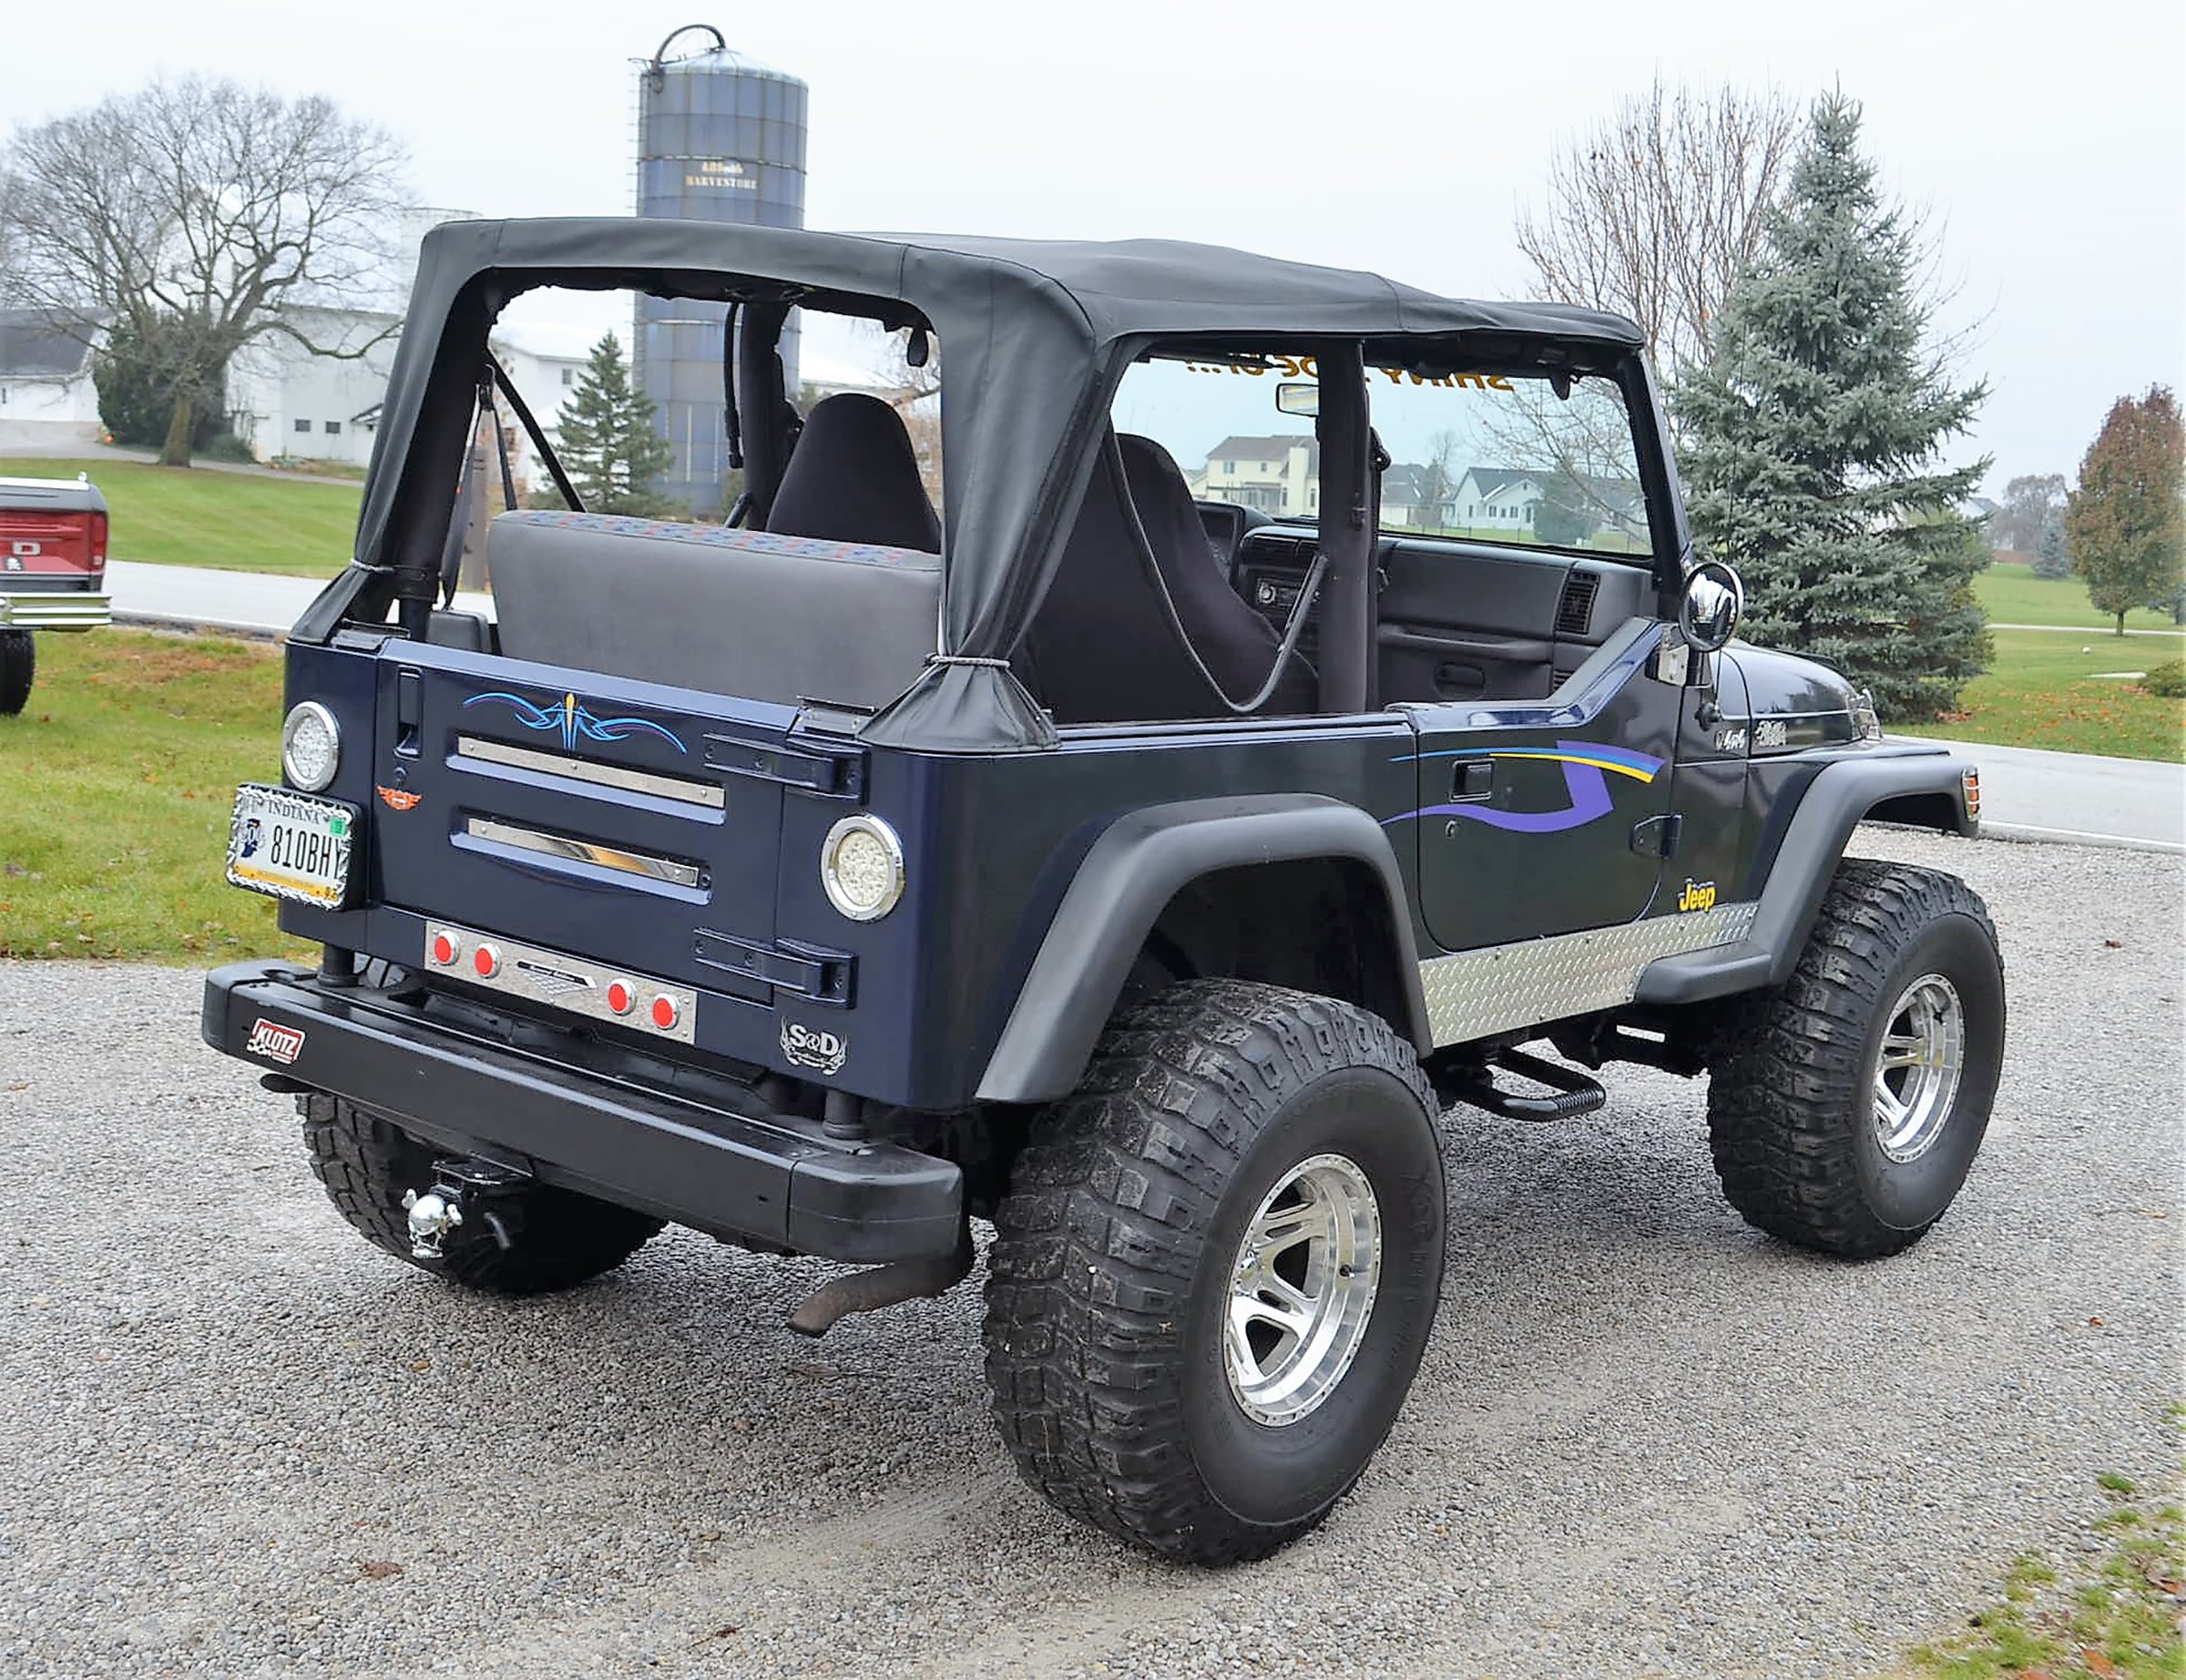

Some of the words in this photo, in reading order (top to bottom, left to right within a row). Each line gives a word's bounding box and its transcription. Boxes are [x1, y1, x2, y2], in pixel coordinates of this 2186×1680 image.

[1679, 880, 1716, 913] Jeep
[256, 1025, 299, 1055] KLOTZ
[789, 1024, 840, 1056] S&D
